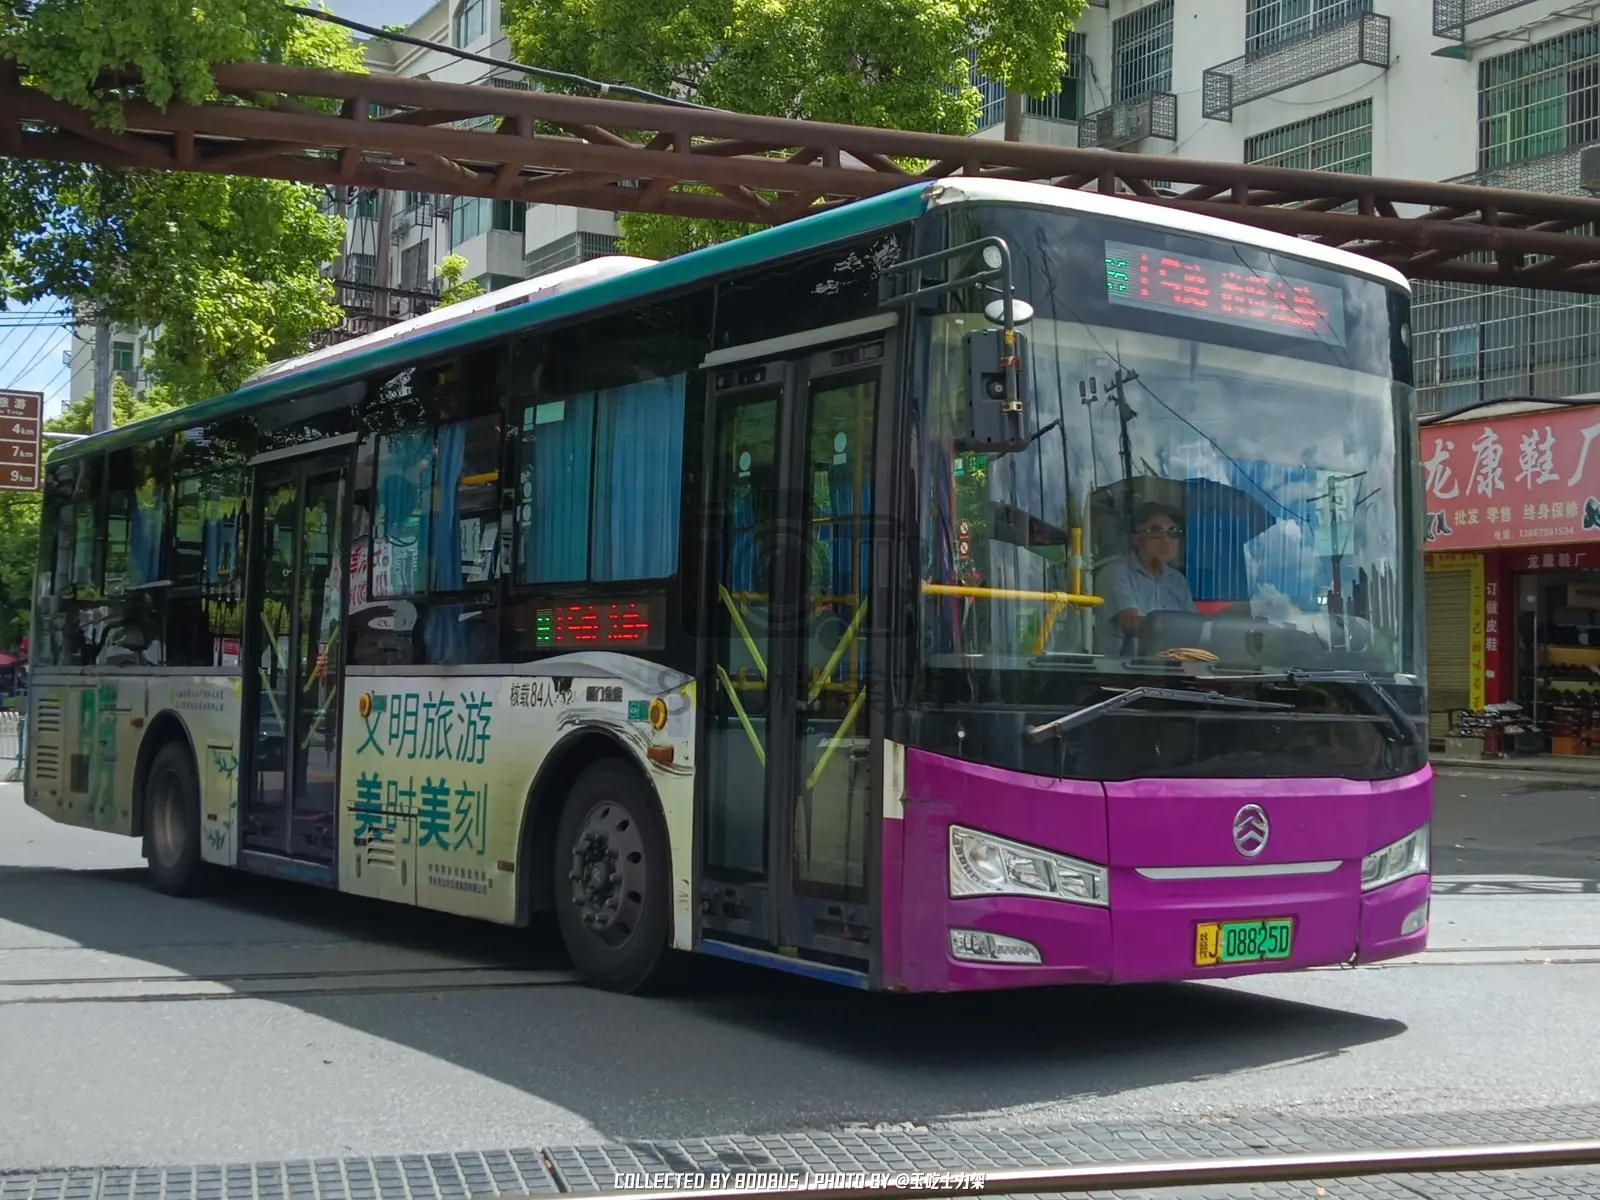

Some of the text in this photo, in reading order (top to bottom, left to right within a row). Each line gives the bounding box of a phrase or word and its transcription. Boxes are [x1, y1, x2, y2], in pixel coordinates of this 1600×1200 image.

[1424, 425, 1600, 500] 龙康鞋厂
[1454, 501, 1579, 525] 批发 零售 终身保修
[356, 689, 493, 764] 文明旅游
[354, 771, 488, 855] 美时美刻
